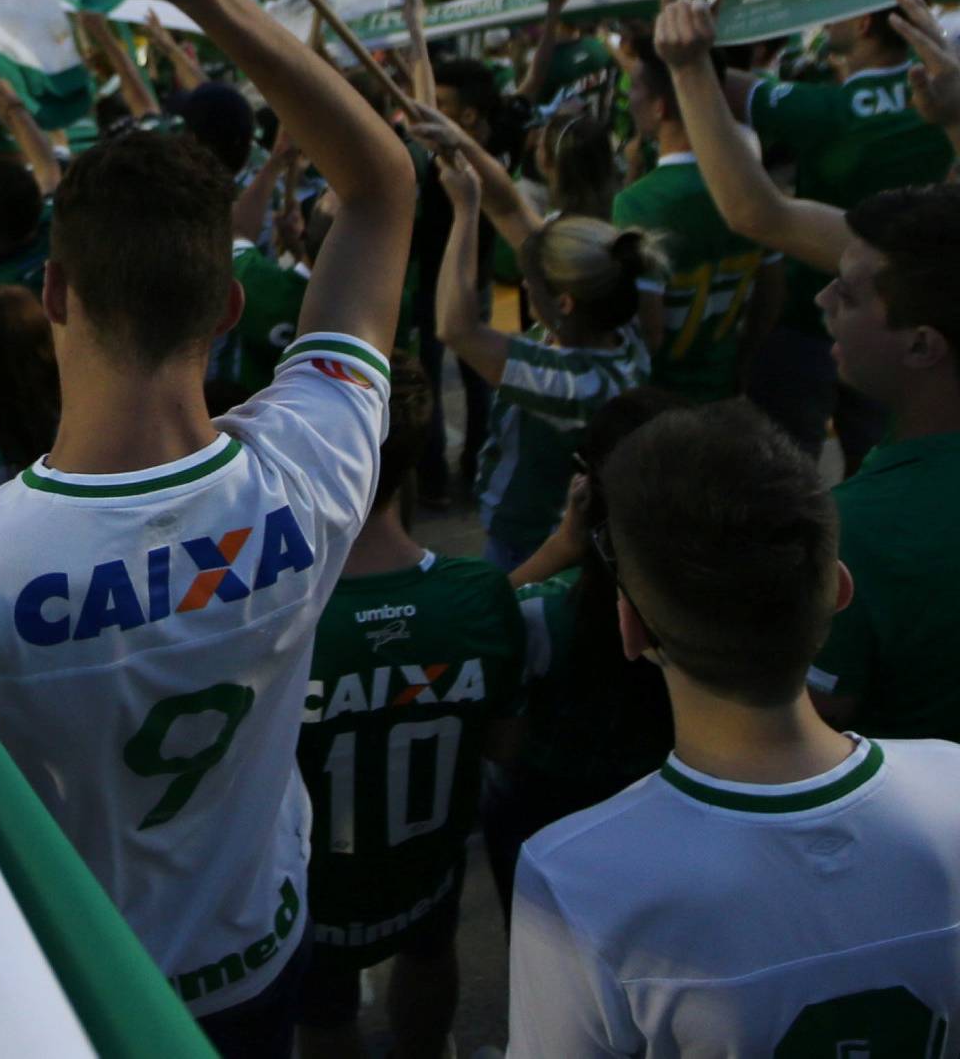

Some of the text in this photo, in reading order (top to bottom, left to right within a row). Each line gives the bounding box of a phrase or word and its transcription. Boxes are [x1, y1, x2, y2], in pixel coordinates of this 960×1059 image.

[850, 82, 907, 118] CAI
[14, 504, 314, 647] CAIXA
[354, 604, 416, 623] umbro
[123, 683, 255, 831] 9
[322, 715, 464, 854] 10
[168, 877, 300, 1003] med
